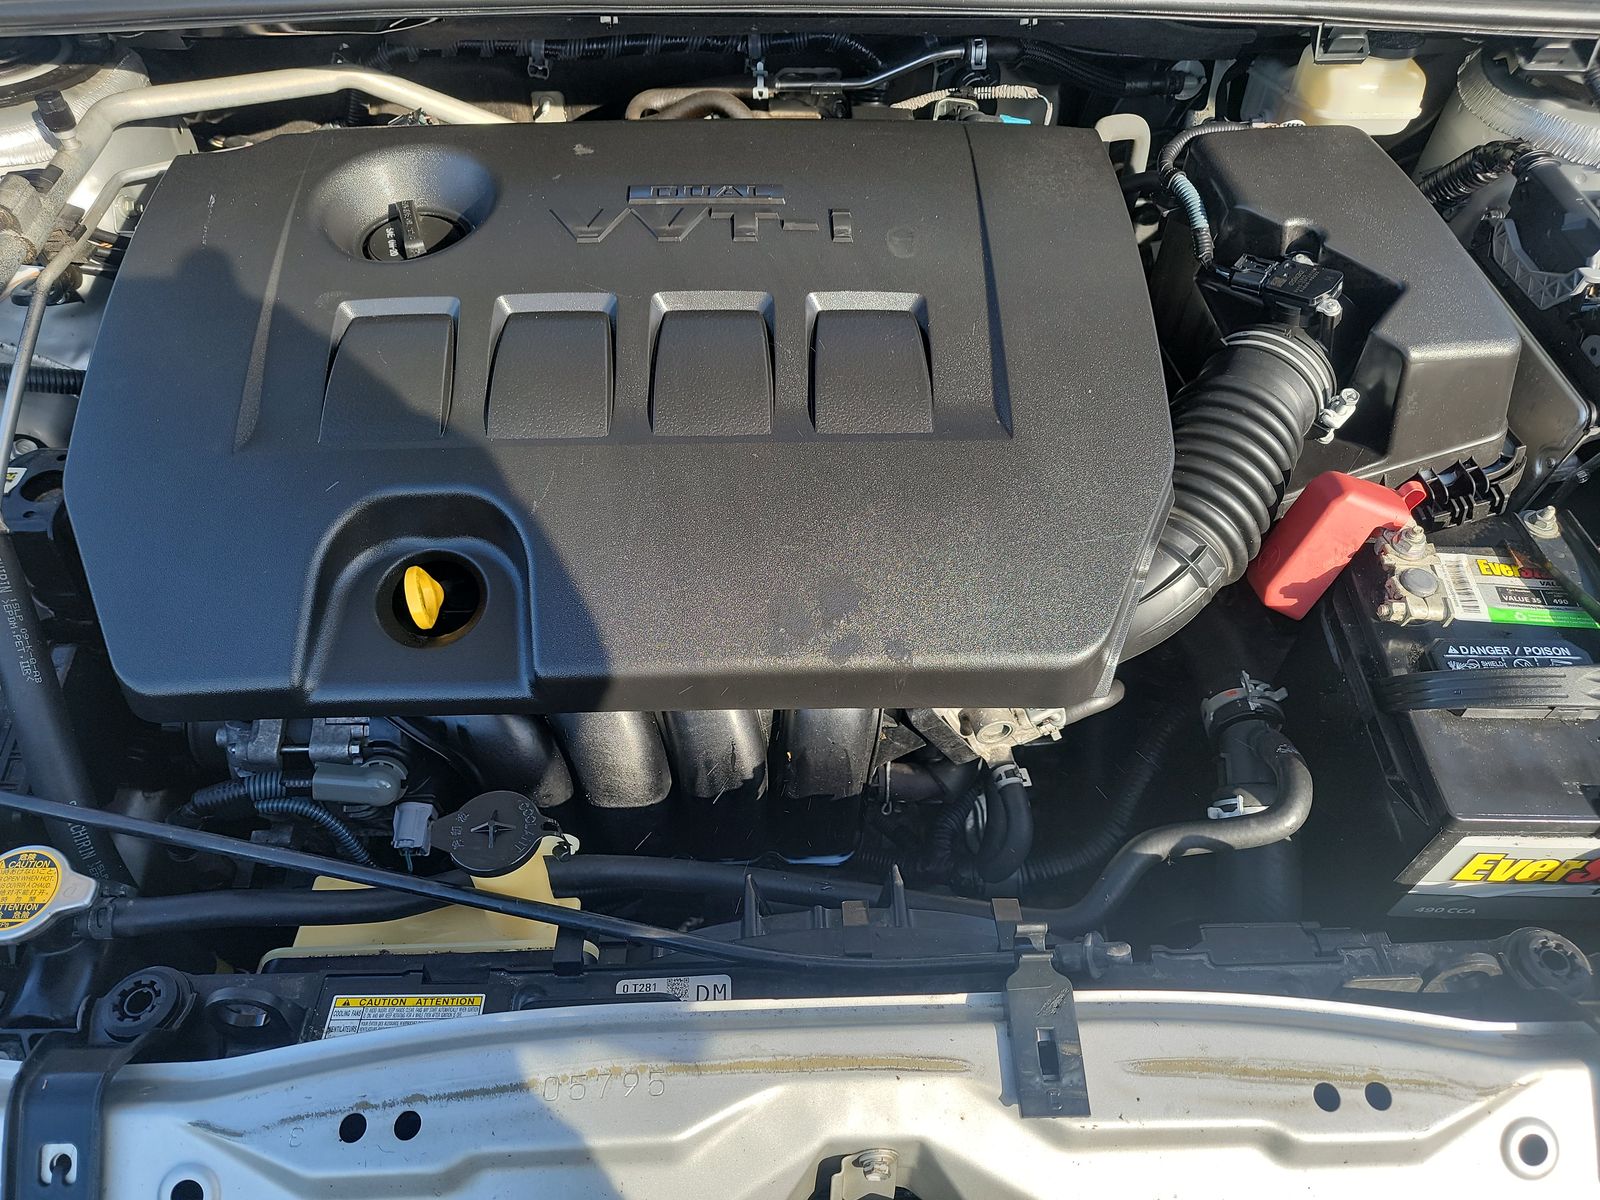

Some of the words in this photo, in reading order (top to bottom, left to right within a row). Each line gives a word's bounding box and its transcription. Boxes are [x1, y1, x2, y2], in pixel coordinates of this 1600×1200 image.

[650, 184, 768, 198] DUAL
[1502, 595, 1530, 603] VALUE
[1531, 596, 1542, 604] 35
[1458, 645, 1512, 655] DANGER
[1523, 646, 1572, 656] POISON
[1480, 660, 1503, 668] SHIELD
[8, 860, 51, 868] CAUTION
[0, 903, 39, 911] TTENTION
[1414, 906, 1444, 914] 490
[696, 984, 727, 1001] DM
[359, 998, 407, 1006] CAUTION
[415, 998, 476, 1006] ATTENTION
[333, 1009, 351, 1017] COOLING
[541, 1070, 667, 1102] 05795
